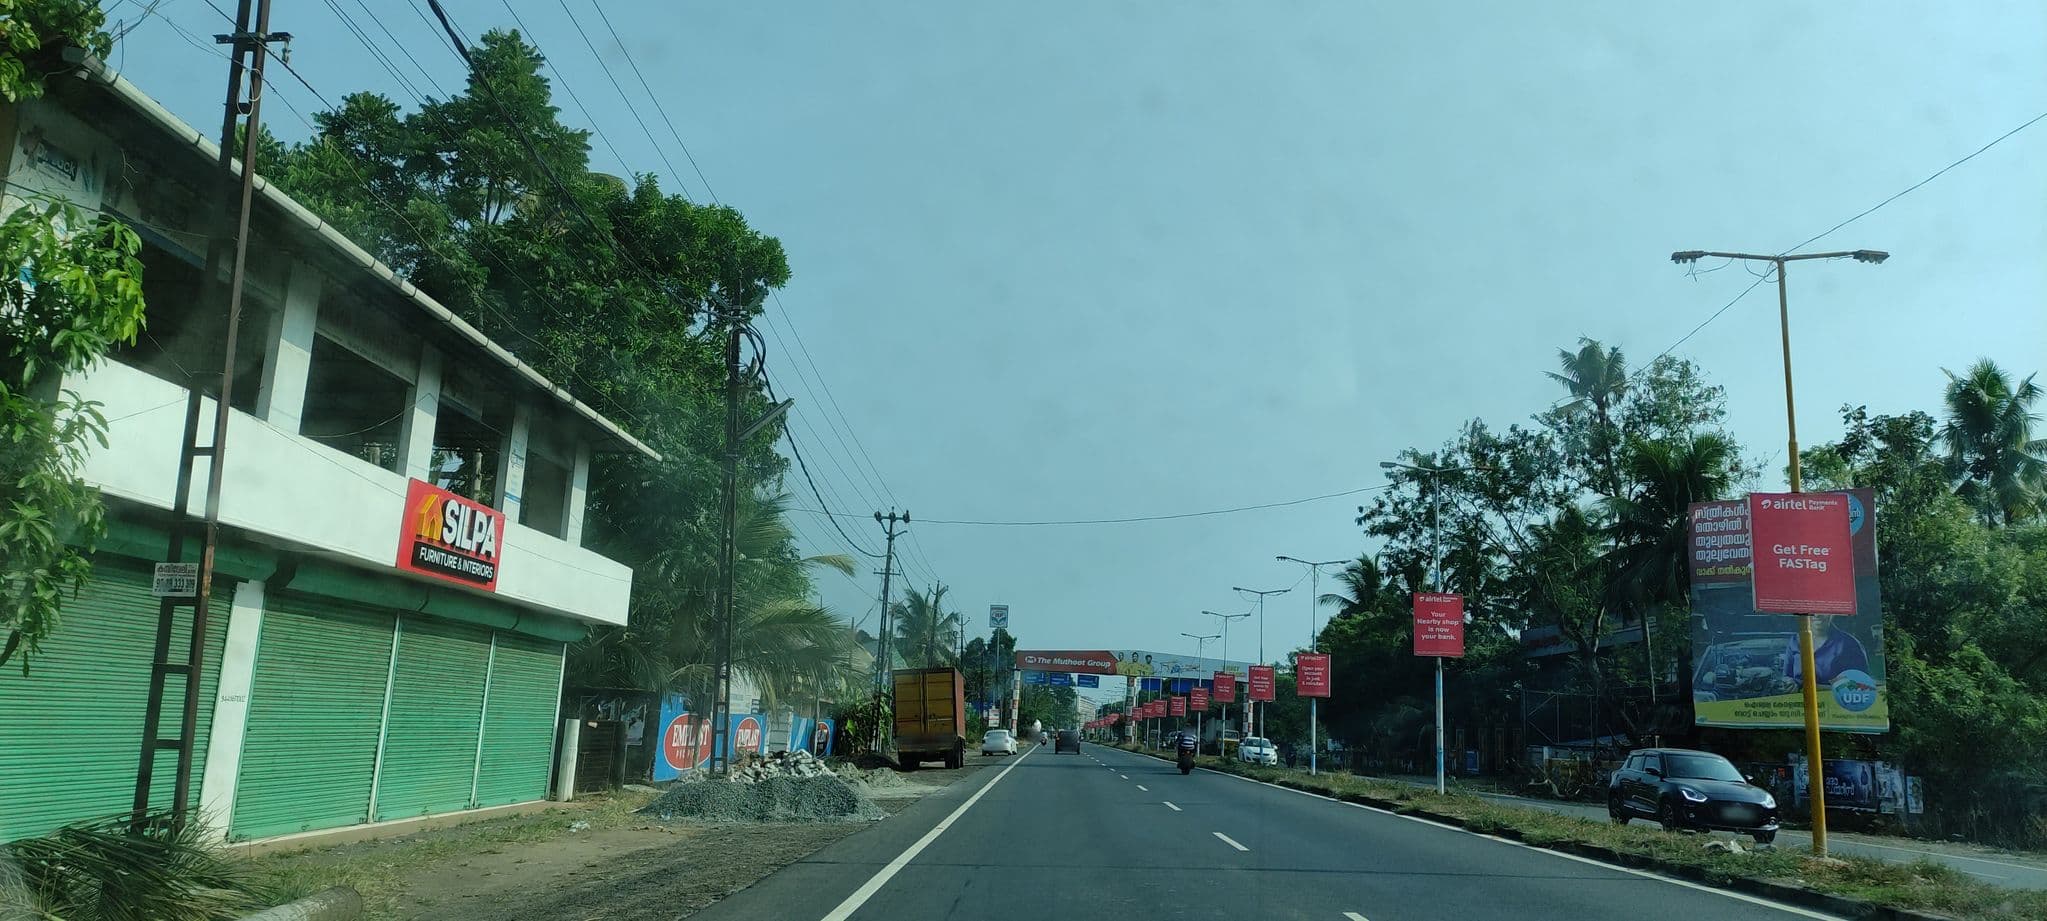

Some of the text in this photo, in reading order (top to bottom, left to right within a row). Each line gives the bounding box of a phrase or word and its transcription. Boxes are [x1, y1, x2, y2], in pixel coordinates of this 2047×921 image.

[1774, 499, 1806, 510] airtel
[442, 499, 495, 558] SILPA
[1773, 544, 1829, 556] Get Free
[420, 547, 493, 578] FURNITURE & INTERIORS
[1779, 559, 1827, 572] FASTag
[1053, 658, 1085, 666] Muthoot
[1087, 660, 1111, 668] Group
[1843, 693, 1870, 703] UDF
